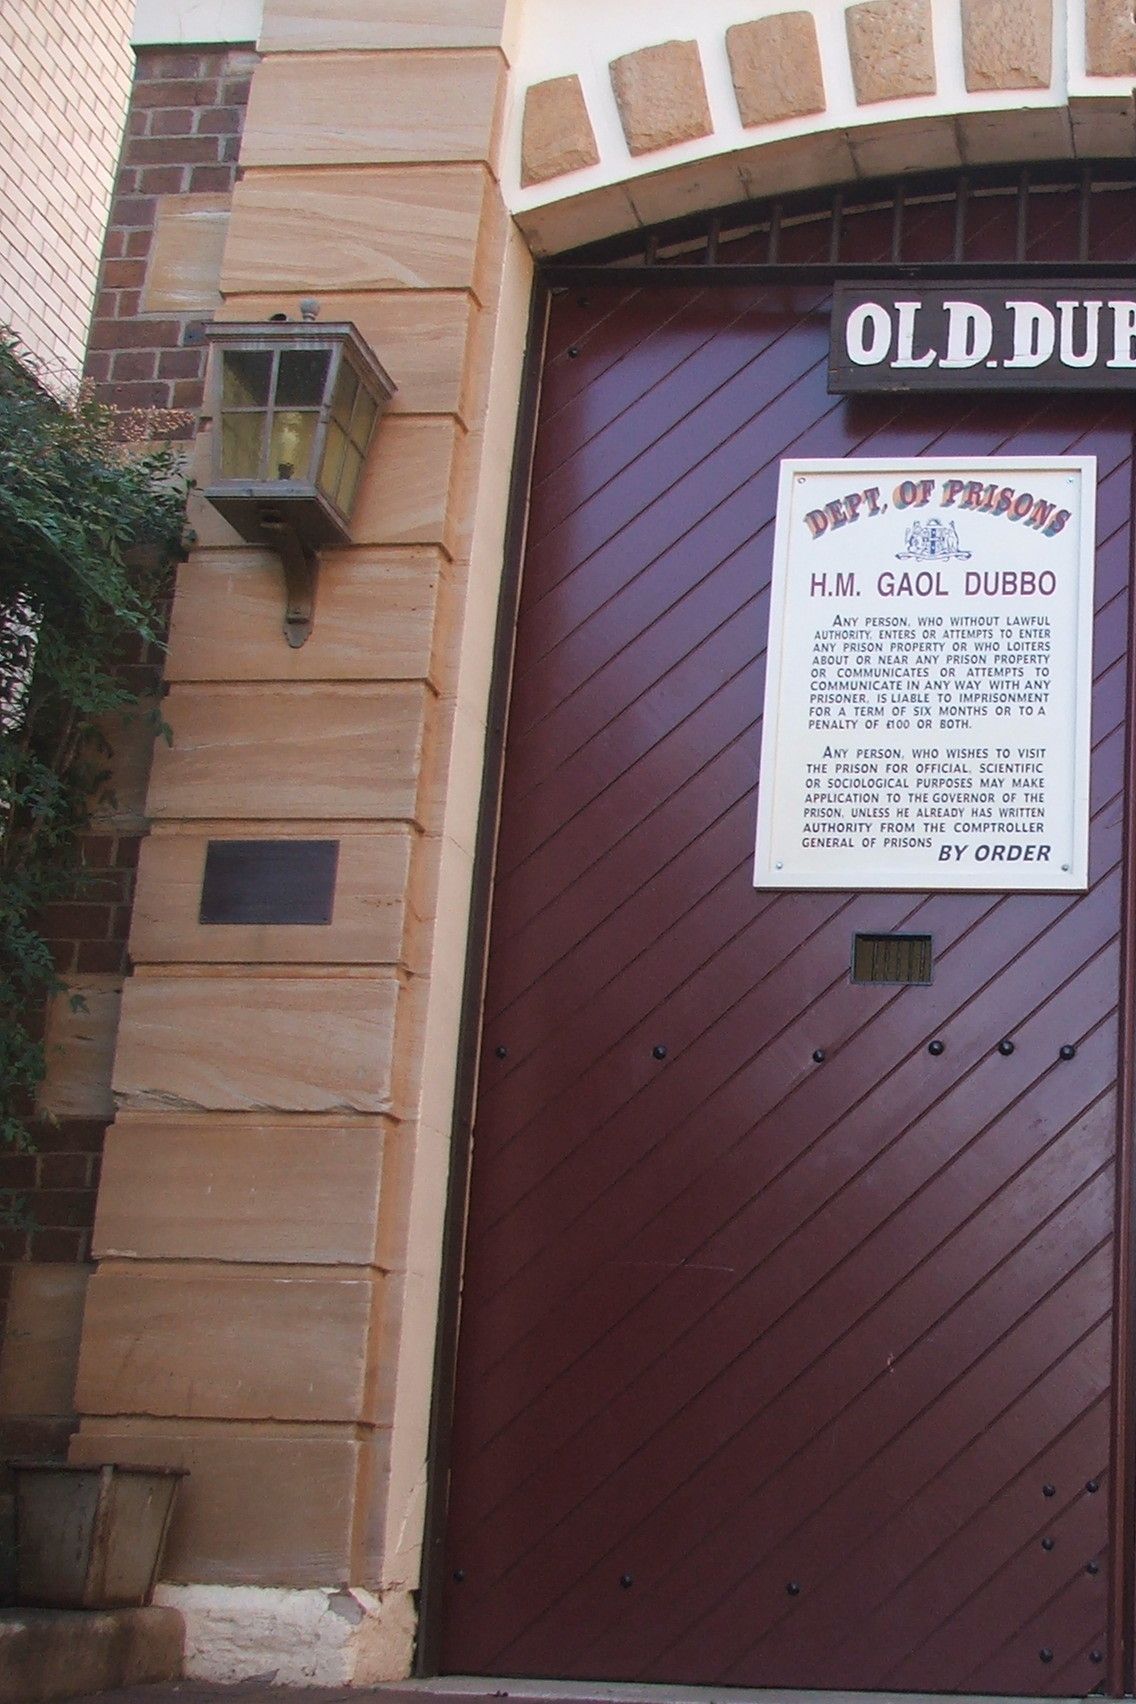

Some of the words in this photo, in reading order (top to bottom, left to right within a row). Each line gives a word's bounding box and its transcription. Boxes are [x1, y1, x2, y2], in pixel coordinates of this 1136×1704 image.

[892, 479, 935, 509] OF
[940, 479, 1072, 538] PRISONS
[810, 573, 861, 597] H.M.
[877, 571, 949, 597] GAOL
[965, 570, 1057, 596] DUBBO
[918, 616, 943, 627] WHO
[950, 615, 1000, 627] WITHOUT
[1007, 615, 1051, 626] LAWFUL
[879, 629, 916, 640] ENTERS
[922, 629, 936, 640] OR
[942, 628, 994, 640] ATTEMPTS
[1000, 628, 1013, 639] TO
[1019, 628, 1051, 639] ENTER
[813, 642, 836, 653] ANY
[843, 641, 883, 653] PRISON
[890, 641, 946, 652] PROPERTY
[952, 641, 967, 652] OR
[974, 641, 1000, 652] WHO
[1007, 640, 1051, 652] LOITERS
[812, 654, 849, 666] ABOUT
[856, 654, 872, 665] OR
[878, 654, 908, 666] NEAR
[916, 654, 939, 665] ANY
[946, 653, 987, 665] PRISON
[994, 653, 1051, 665] PROPERTY
[811, 667, 827, 678] OR
[837, 666, 930, 678] COMMUNICATES
[940, 667, 956, 678] OR
[967, 666, 1024, 678] ATTEMPTS
[1035, 666, 1050, 677] TO
[810, 679, 903, 691] COMMUNICATE
[907, 680, 920, 690] IN
[924, 679, 951, 690] ANY
[954, 679, 983, 690] WAY
[989, 679, 1020, 691] WITH
[1025, 679, 1052, 690] ANY
[877, 693, 887, 704] IS
[891, 692, 930, 704] LIABLE
[937, 692, 952, 703] TO
[959, 692, 1050, 704] IMPRISONMENT
[809, 706, 831, 717] FOR
[837, 706, 847, 716] A
[854, 705, 885, 717] TERM
[892, 705, 907, 717] OF
[913, 705, 932, 717] SIX
[939, 705, 988, 716] MONTHS
[995, 705, 1011, 716] OR
[1019, 705, 1034, 716] TO
[1037, 705, 1046, 716] A
[808, 718, 859, 730] PENALTY
[865, 719, 879, 729] OF
[886, 718, 910, 730] £100
[917, 718, 932, 729] OR
[912, 748, 939, 759] WHO
[946, 748, 989, 759] WISHES
[995, 748, 1011, 759] TO
[1017, 747, 1046, 759] VISIT
[807, 763, 828, 774] THE
[835, 762, 878, 775] PRISON
[886, 763, 909, 774] FOR
[979, 762, 1044, 774] SCIENTIFIC
[805, 777, 821, 789] OR
[827, 777, 910, 789] SOCIOLOGICAL
[916, 777, 973, 789] PURPOSES
[980, 777, 1005, 788] MAY
[1012, 777, 1045, 789] MAKE
[805, 792, 880, 804] APPLICATION
[886, 792, 901, 803] TO
[908, 792, 929, 803] THE
[932, 792, 995, 803] GOVERNOR
[1002, 792, 1017, 803] OF
[1024, 792, 1045, 803] THE
[851, 807, 890, 818] UNLESS
[896, 807, 910, 818] HE
[916, 807, 965, 818] ALREADY
[971, 807, 993, 818] HAS
[999, 807, 1045, 818] WRITTEN
[802, 822, 873, 833] AUTHORITY
[880, 822, 915, 833] FROM
[923, 822, 946, 833] THE
[953, 821, 1044, 833] COMPTROLLER
[802, 836, 855, 848] GENERAL
[862, 837, 877, 848] OF
[883, 836, 932, 848] PRISONS
[938, 845, 969, 862] BY
[975, 844, 1051, 862] ORDER
